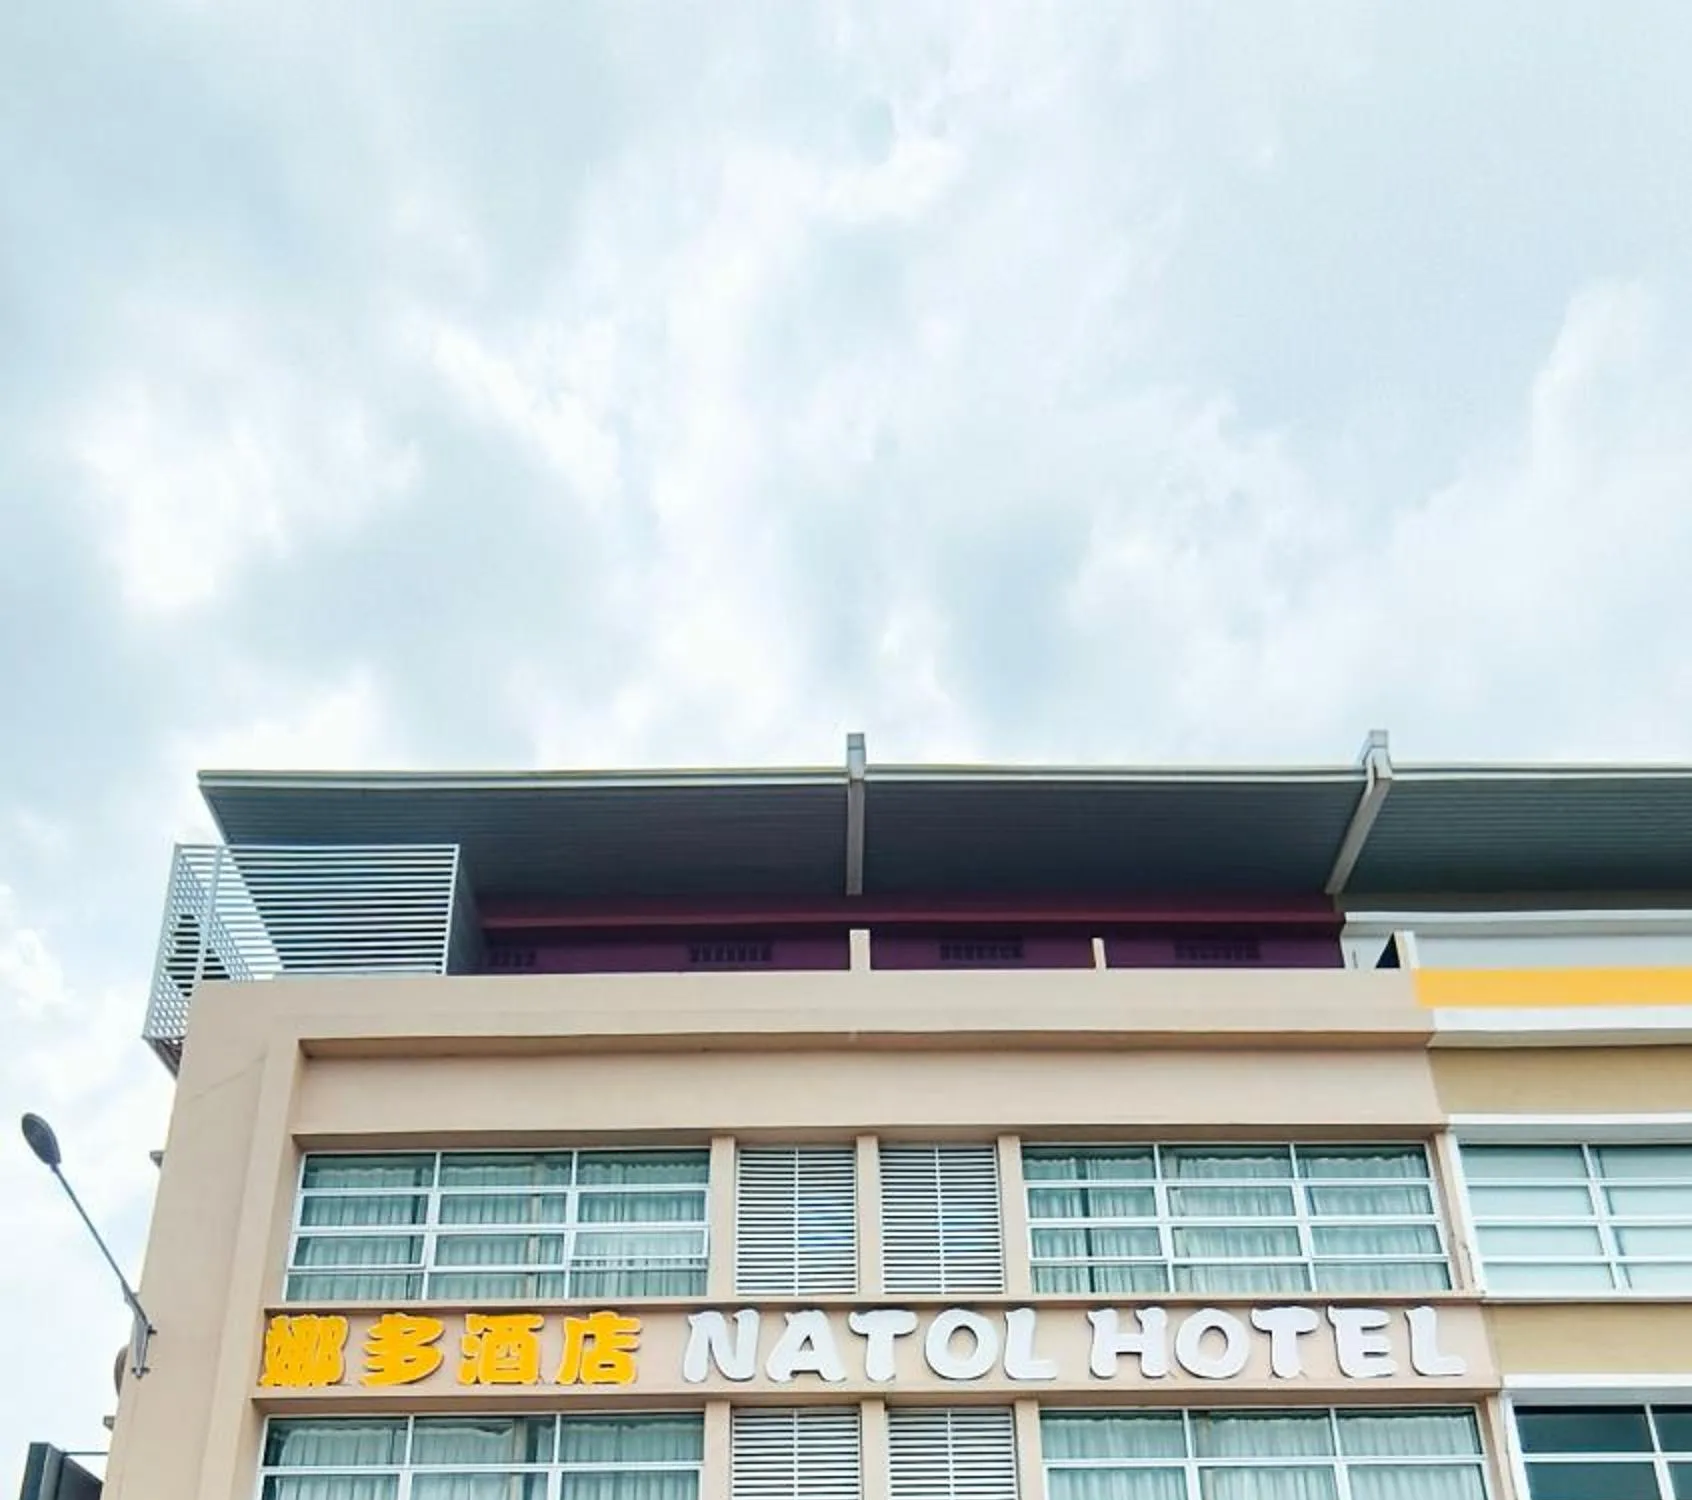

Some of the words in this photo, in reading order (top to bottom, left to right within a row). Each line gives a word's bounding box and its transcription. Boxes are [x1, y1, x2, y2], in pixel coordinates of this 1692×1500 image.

[258, 1310, 643, 1387] 娜多酒店
[683, 1308, 1059, 1383] NATOL
[1088, 1305, 1468, 1379] HOTEL
